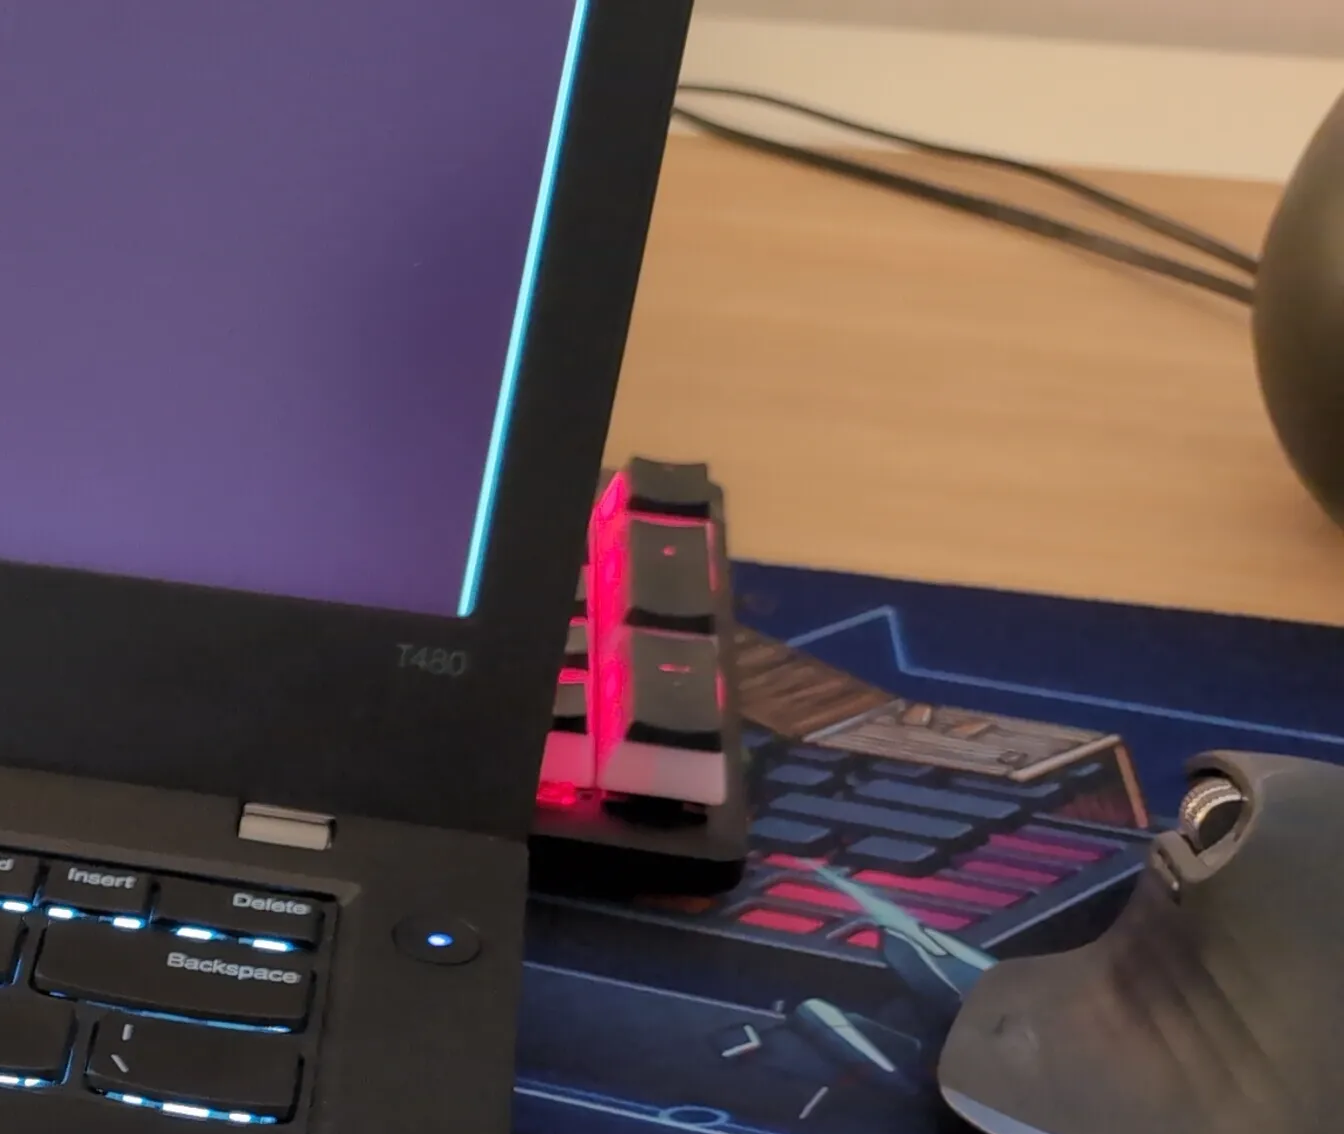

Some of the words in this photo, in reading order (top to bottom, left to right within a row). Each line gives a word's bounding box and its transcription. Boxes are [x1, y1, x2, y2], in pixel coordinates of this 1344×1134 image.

[396, 643, 467, 677] T480
[67, 867, 136, 890] Insert
[232, 892, 312, 916] Delete
[166, 952, 303, 986] Backspace
